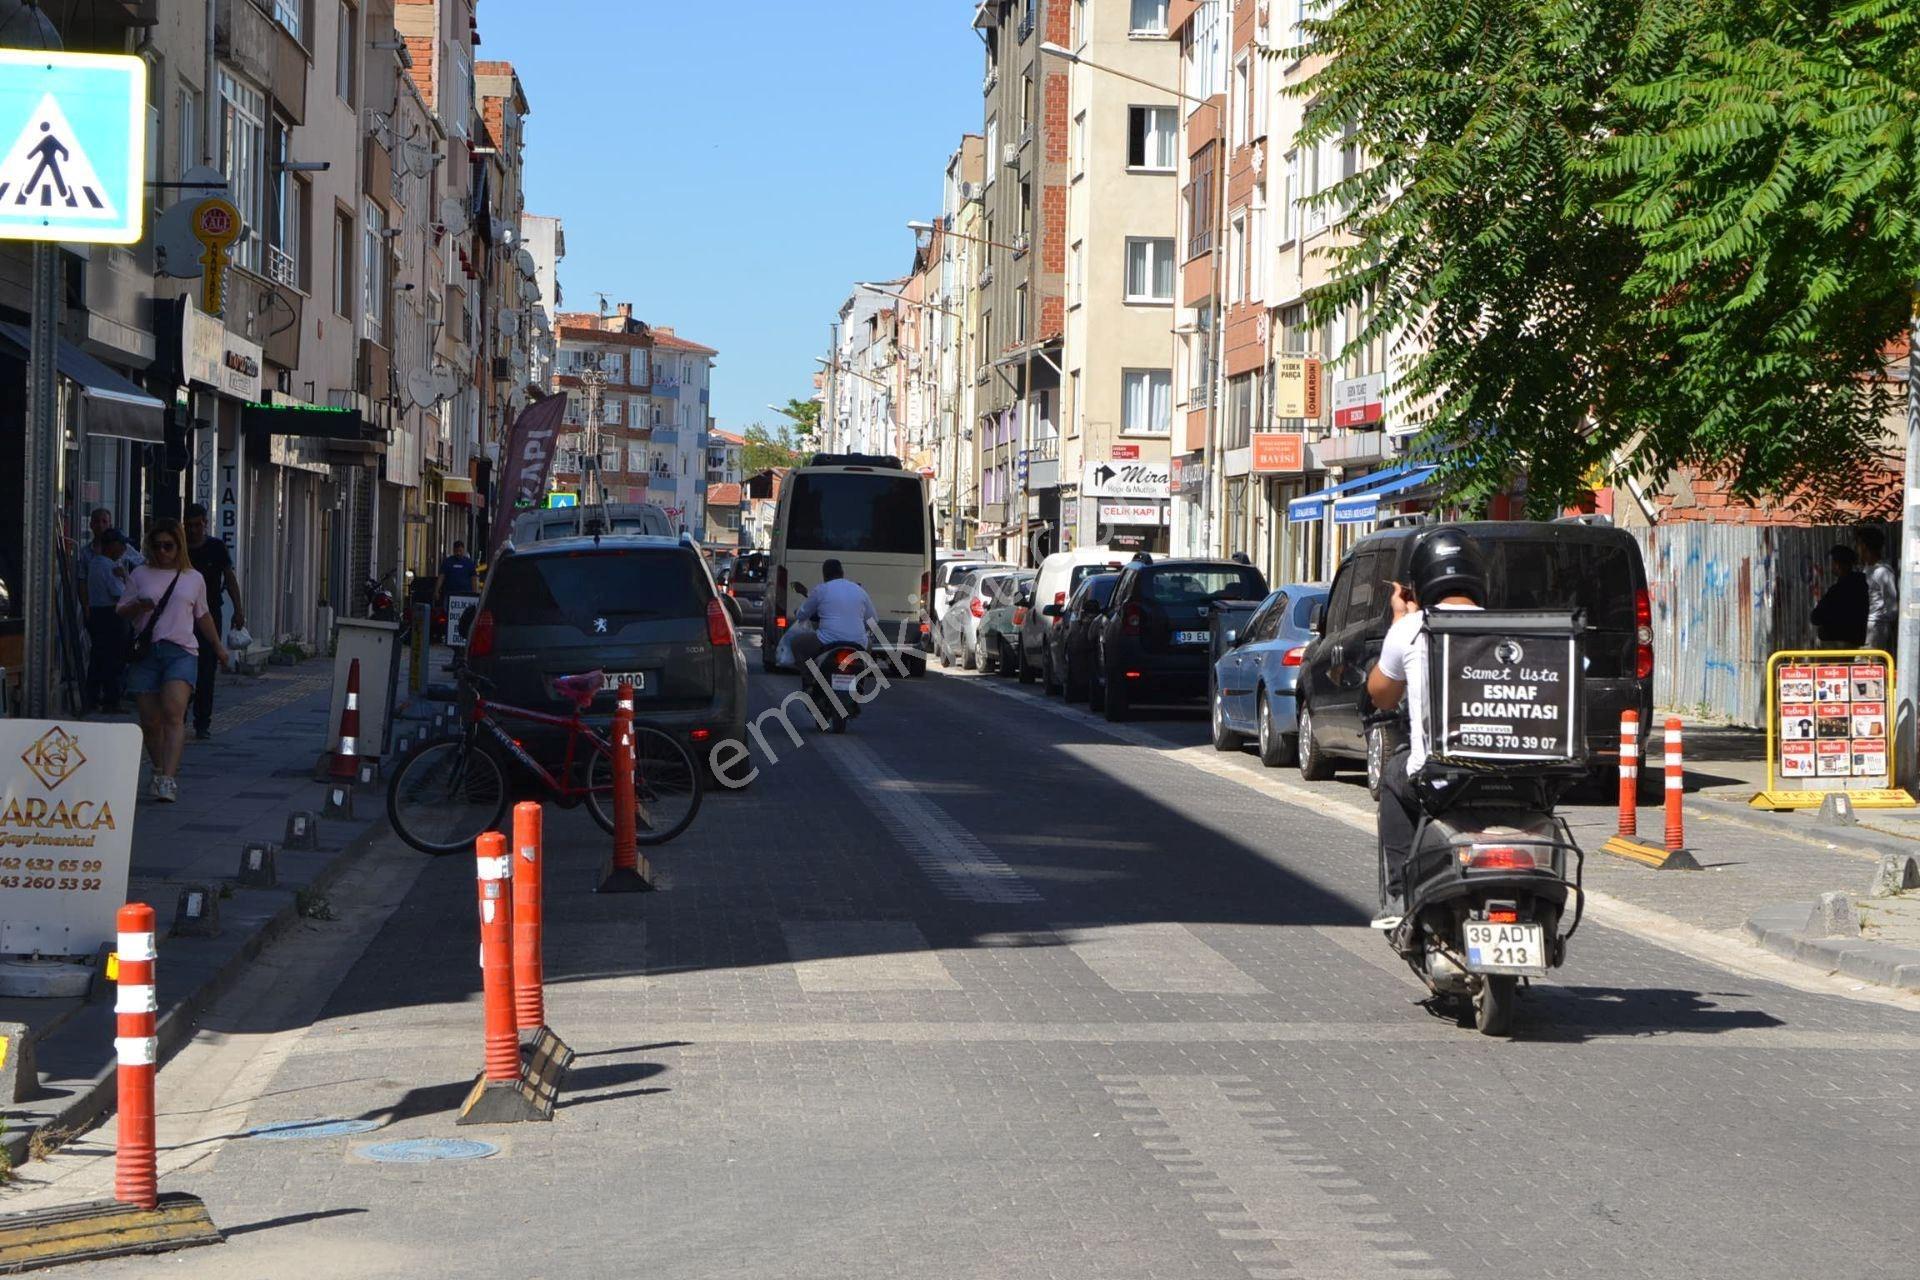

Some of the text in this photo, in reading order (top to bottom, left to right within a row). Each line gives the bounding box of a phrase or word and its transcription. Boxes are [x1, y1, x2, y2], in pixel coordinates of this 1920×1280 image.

[1120, 465, 1168, 484] Mira
[1133, 507, 1155, 516] KAPI
[1461, 666, 1512, 680] Samet
[1483, 684, 1537, 701] ESNAF
[1461, 702, 1558, 720] LOKANTASI
[1461, 733, 1557, 750] 0530 370 39 07
[0, 796, 116, 830] ARACA
[25, 858, 54, 872] 432
[58, 859, 79, 872] 65
[81, 860, 102, 873] 99
[0, 875, 102, 890] 43 260 53 92
[1469, 926, 1537, 944] 39 ADT
[1493, 947, 1528, 964] 213
